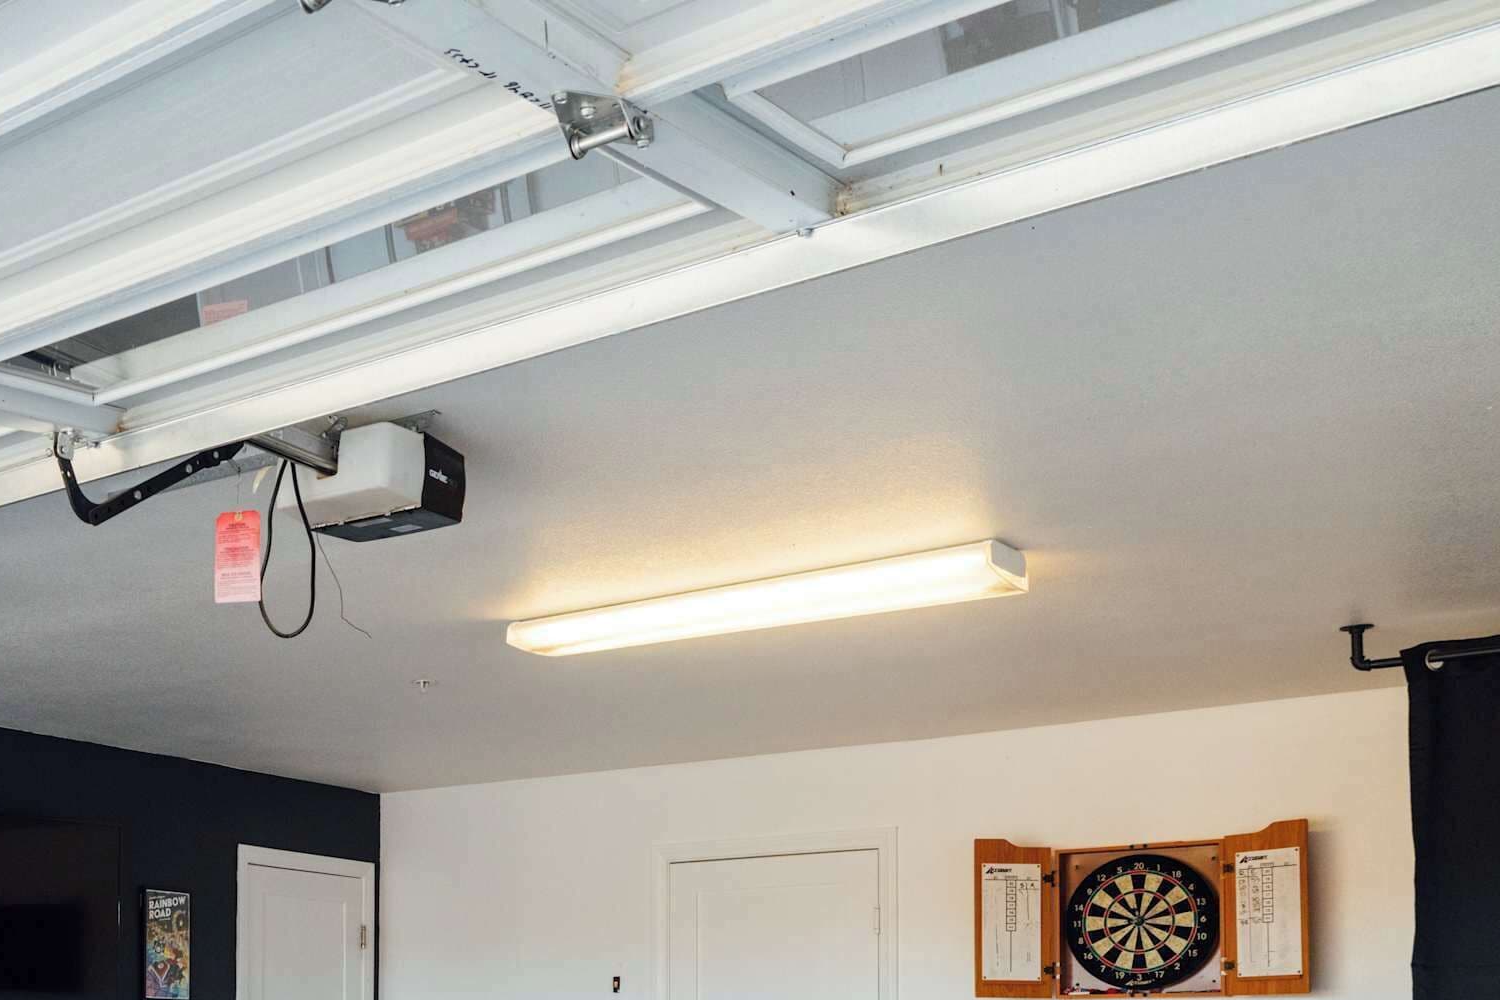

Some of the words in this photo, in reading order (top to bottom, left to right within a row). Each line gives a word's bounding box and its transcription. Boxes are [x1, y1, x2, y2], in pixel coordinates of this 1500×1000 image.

[1116, 866, 1123, 874] 5
[1133, 862, 1145, 870] 20
[1096, 873, 1107, 881] 12
[1171, 870, 1182, 878] 18
[1188, 883, 1195, 891] 4
[1086, 888, 1093, 896] 9
[148, 896, 186, 909] RAINBOW
[1196, 897, 1207, 906] 13
[1074, 904, 1084, 912] 14
[148, 908, 171, 920] ROAD
[1200, 915, 1207, 923] 6
[1197, 932, 1207, 940] 10
[1083, 952, 1094, 960] 16
[1188, 949, 1198, 957] 15
[1100, 965, 1106, 973] 7
[1174, 962, 1181, 971] 2
[1115, 971, 1125, 980] 19
[1155, 971, 1165, 979] 17
